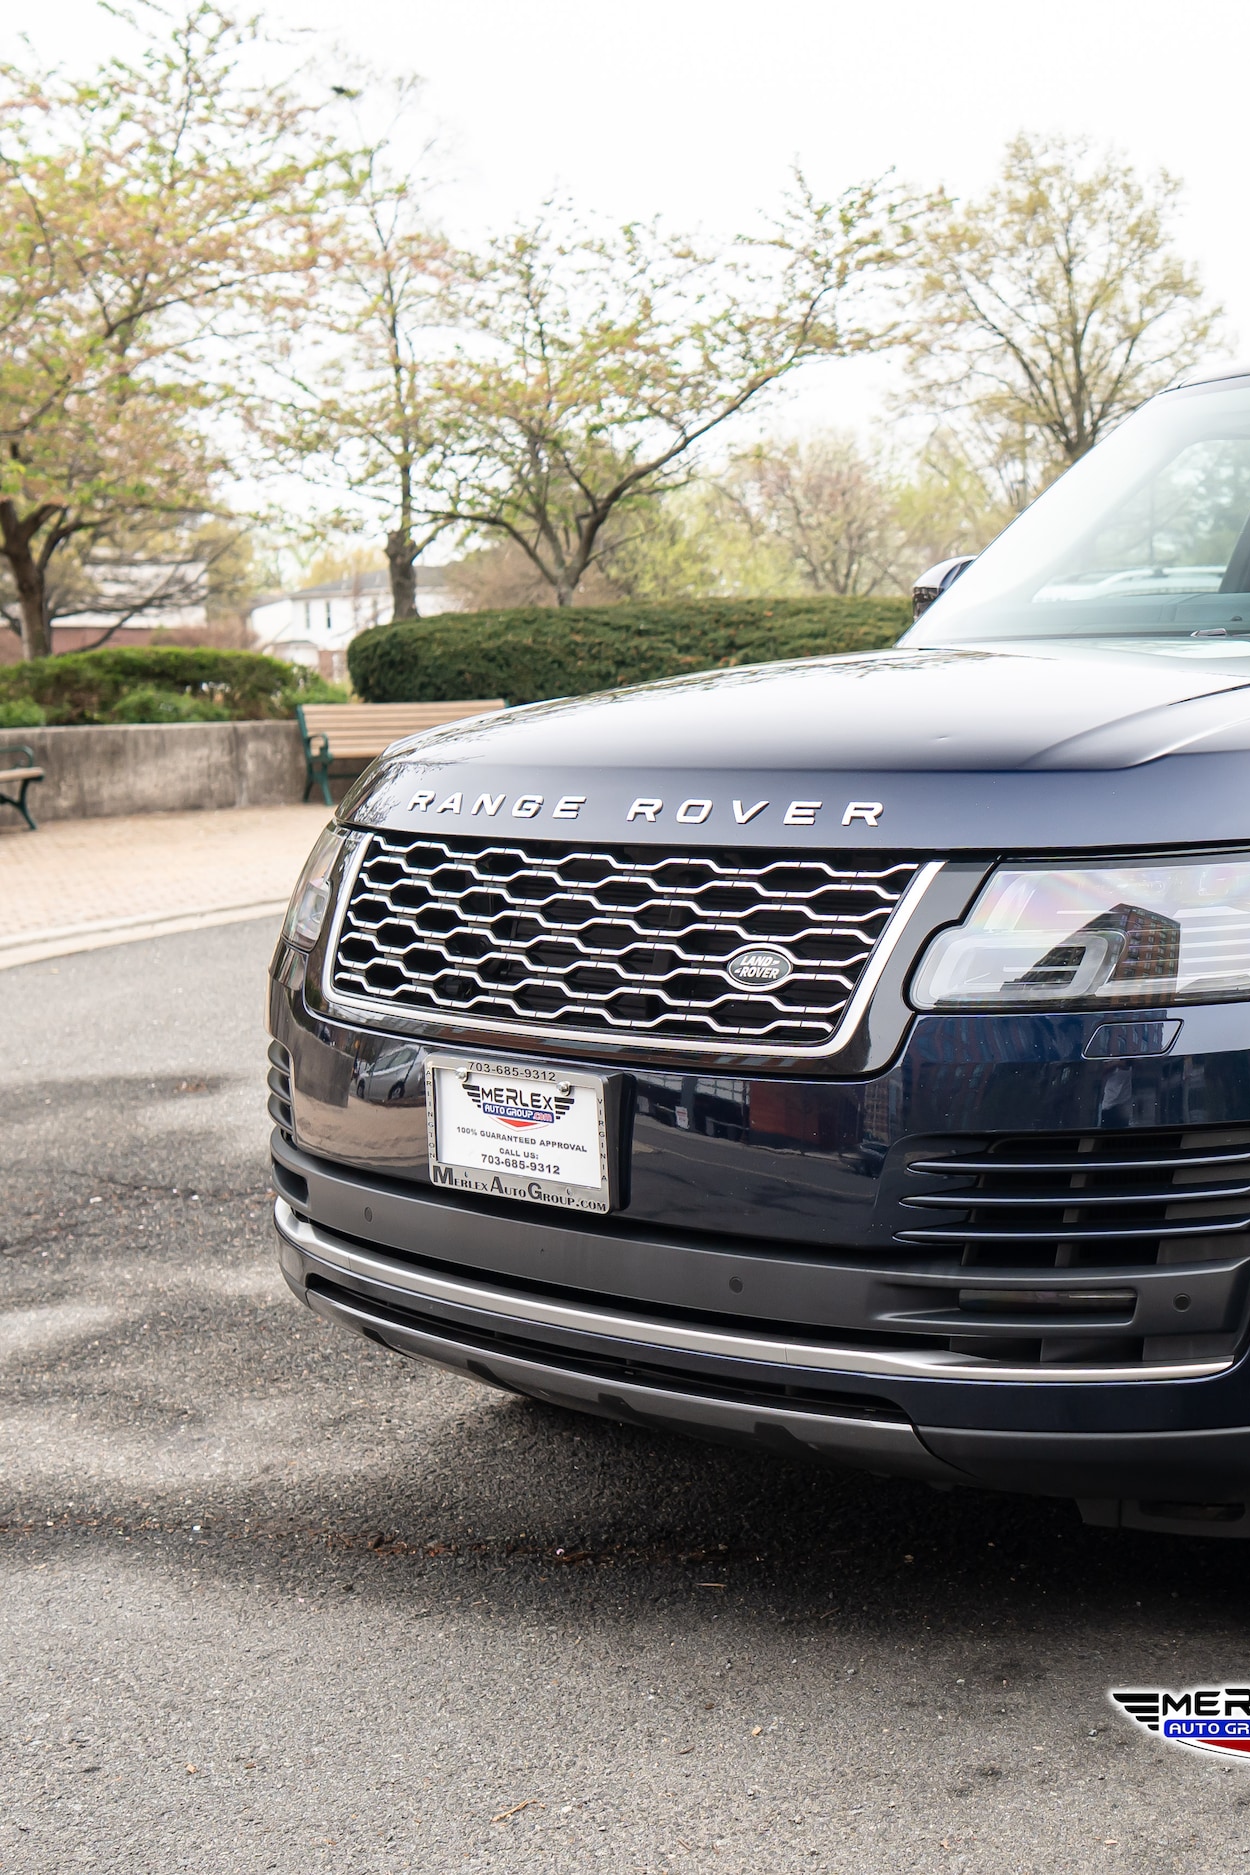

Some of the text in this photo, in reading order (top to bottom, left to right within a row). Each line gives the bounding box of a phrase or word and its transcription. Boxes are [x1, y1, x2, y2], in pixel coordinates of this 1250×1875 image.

[407, 790, 885, 827] RANGE ROVER
[740, 955, 774, 967] LAND
[739, 966, 780, 979] ROVER
[467, 1061, 556, 1082] 703-685-9312
[480, 1086, 554, 1111] MERLEX
[483, 1104, 505, 1115] AUTO
[456, 1126, 588, 1153] 100% GUARANTEED APPROVAL
[597, 1097, 608, 1182] VIRGINIA
[481, 1153, 560, 1175] 703-685-9312
[499, 1147, 539, 1160] CALL US:
